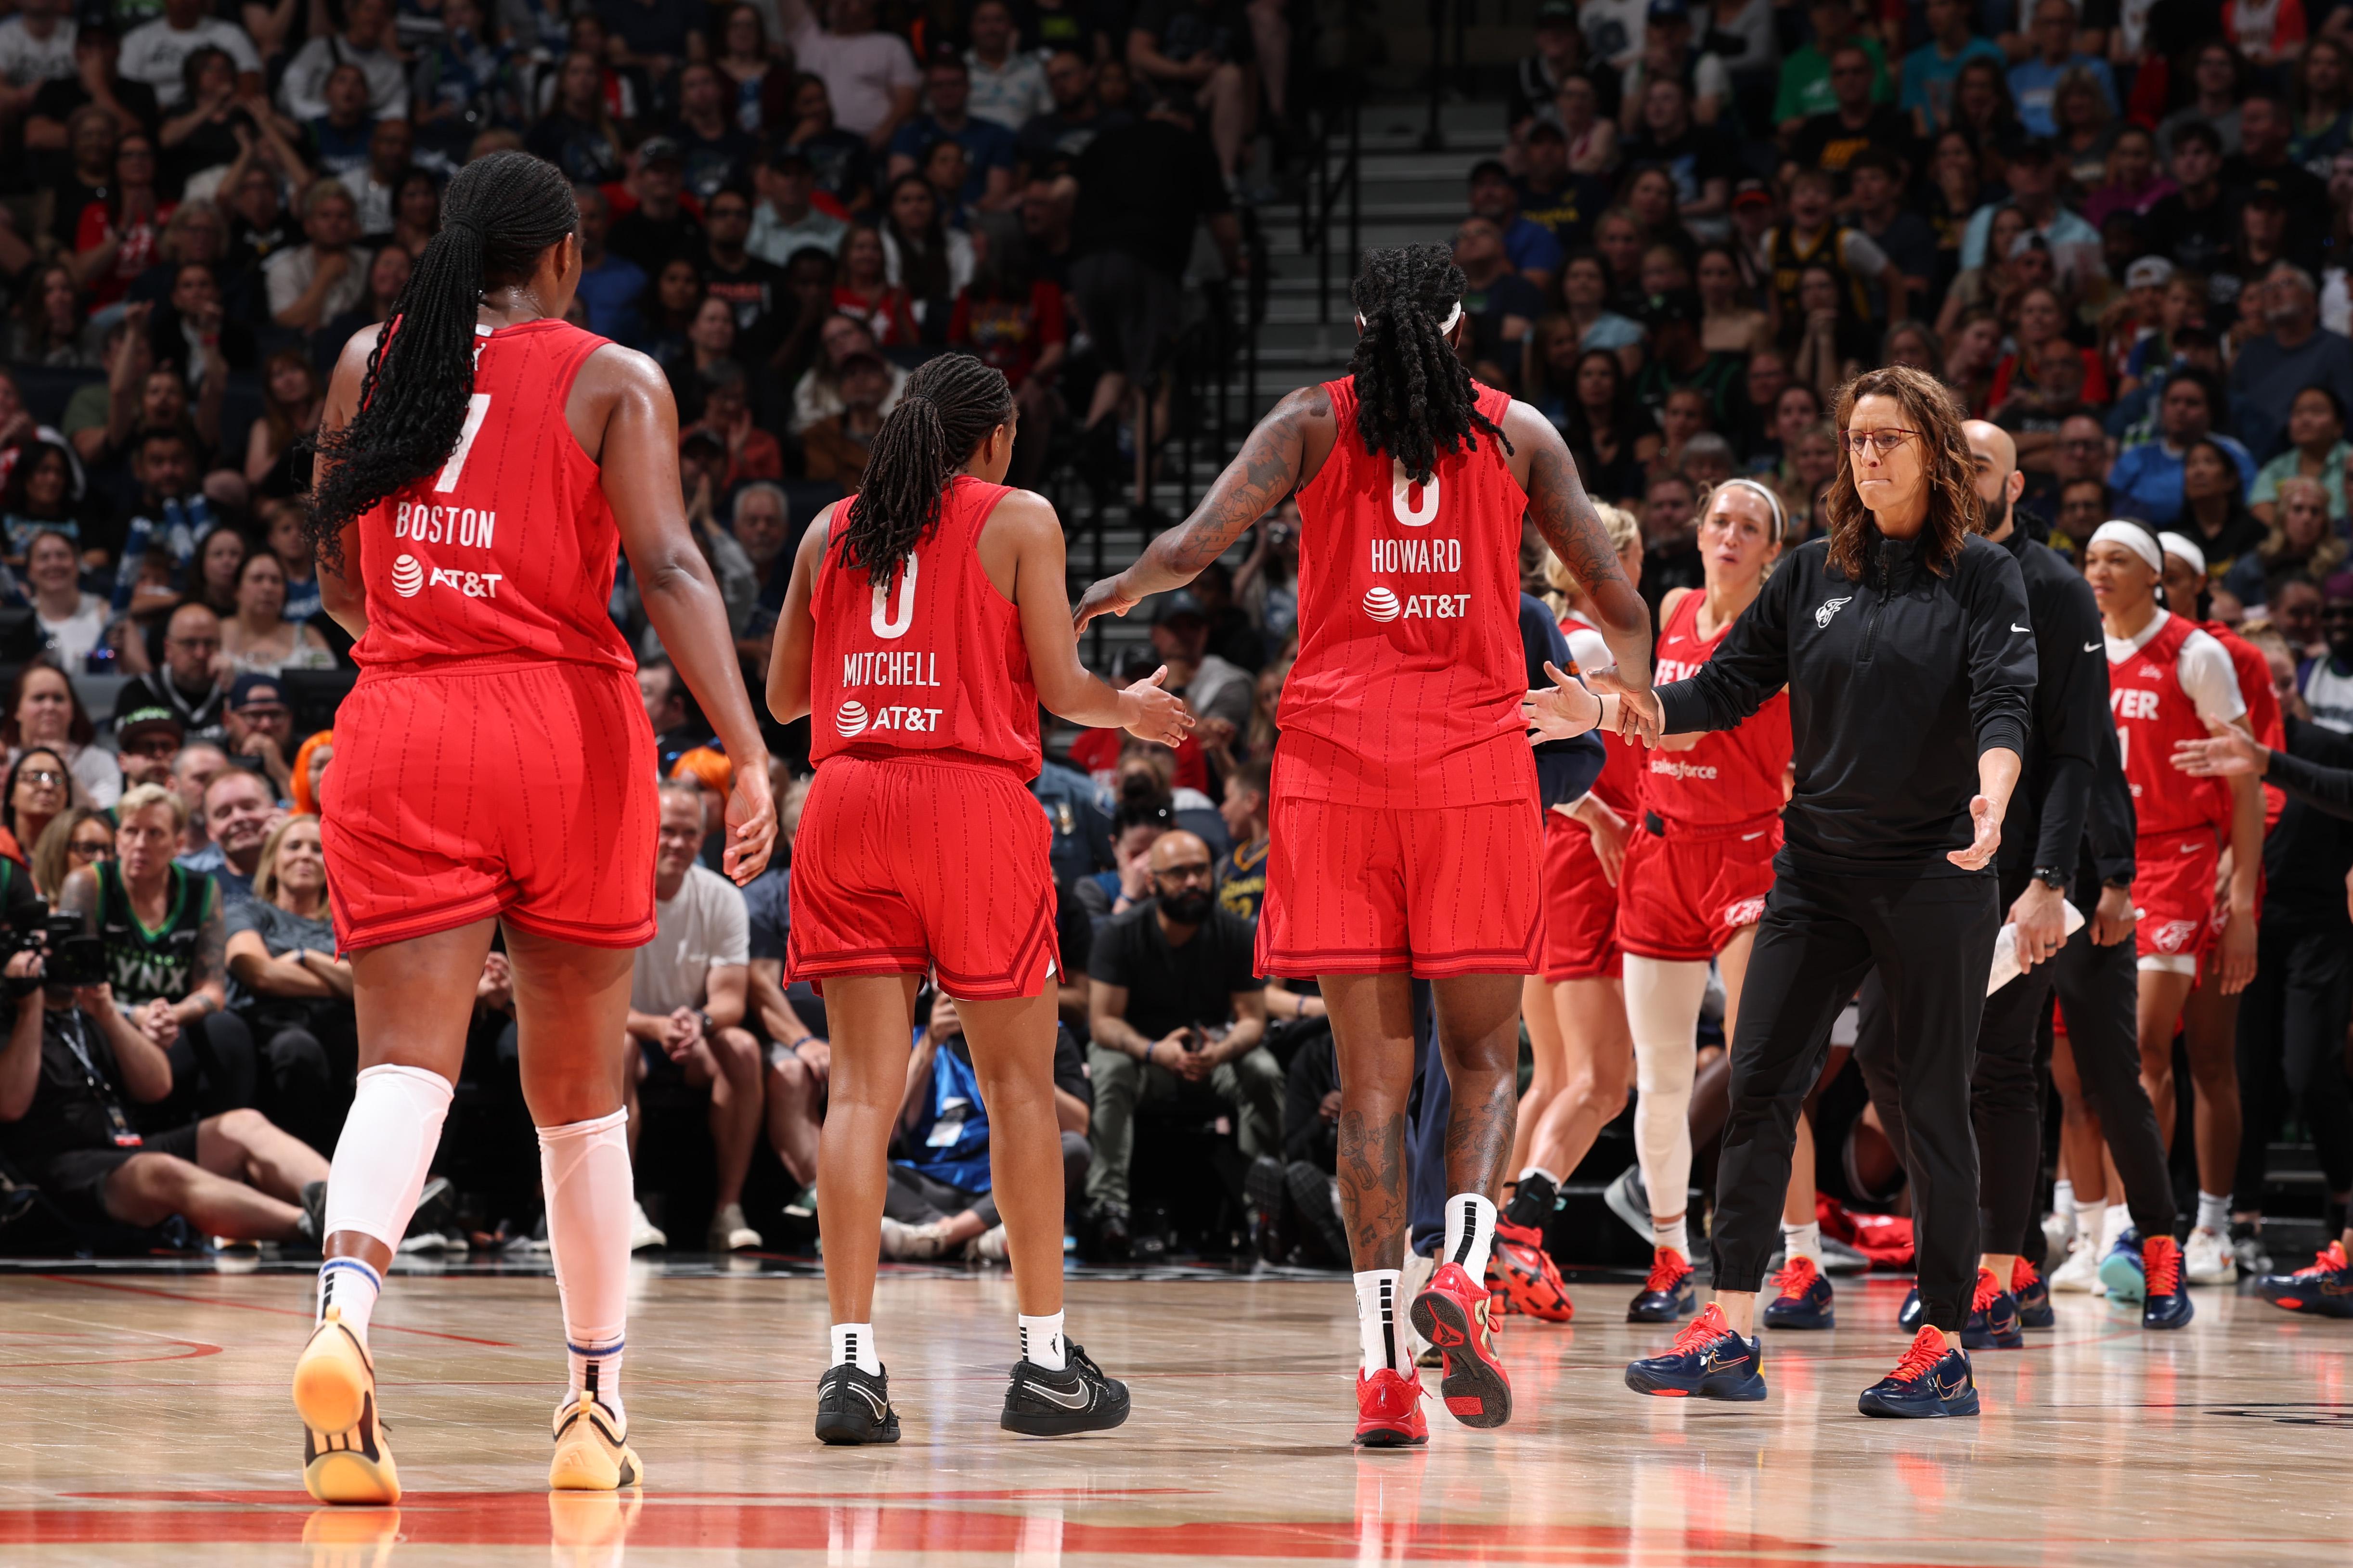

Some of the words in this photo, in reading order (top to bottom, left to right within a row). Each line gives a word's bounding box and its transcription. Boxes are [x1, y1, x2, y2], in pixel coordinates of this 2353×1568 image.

[433, 393, 491, 493] 7
[395, 501, 496, 549] BOSTON
[1371, 538, 1461, 573] HOWARD
[429, 566, 503, 598] AT&T
[870, 548, 919, 639] 0
[1403, 593, 1471, 618] AT&T
[842, 651, 941, 688] MITCHELL
[1654, 658, 1703, 687] FEV
[871, 706, 943, 732] AT&T
[1439, 755, 1448, 806] ASKETBALL
[1650, 757, 1718, 781] salesforce
[1456, 887, 1461, 899] ME
[104, 951, 187, 993] YNX
